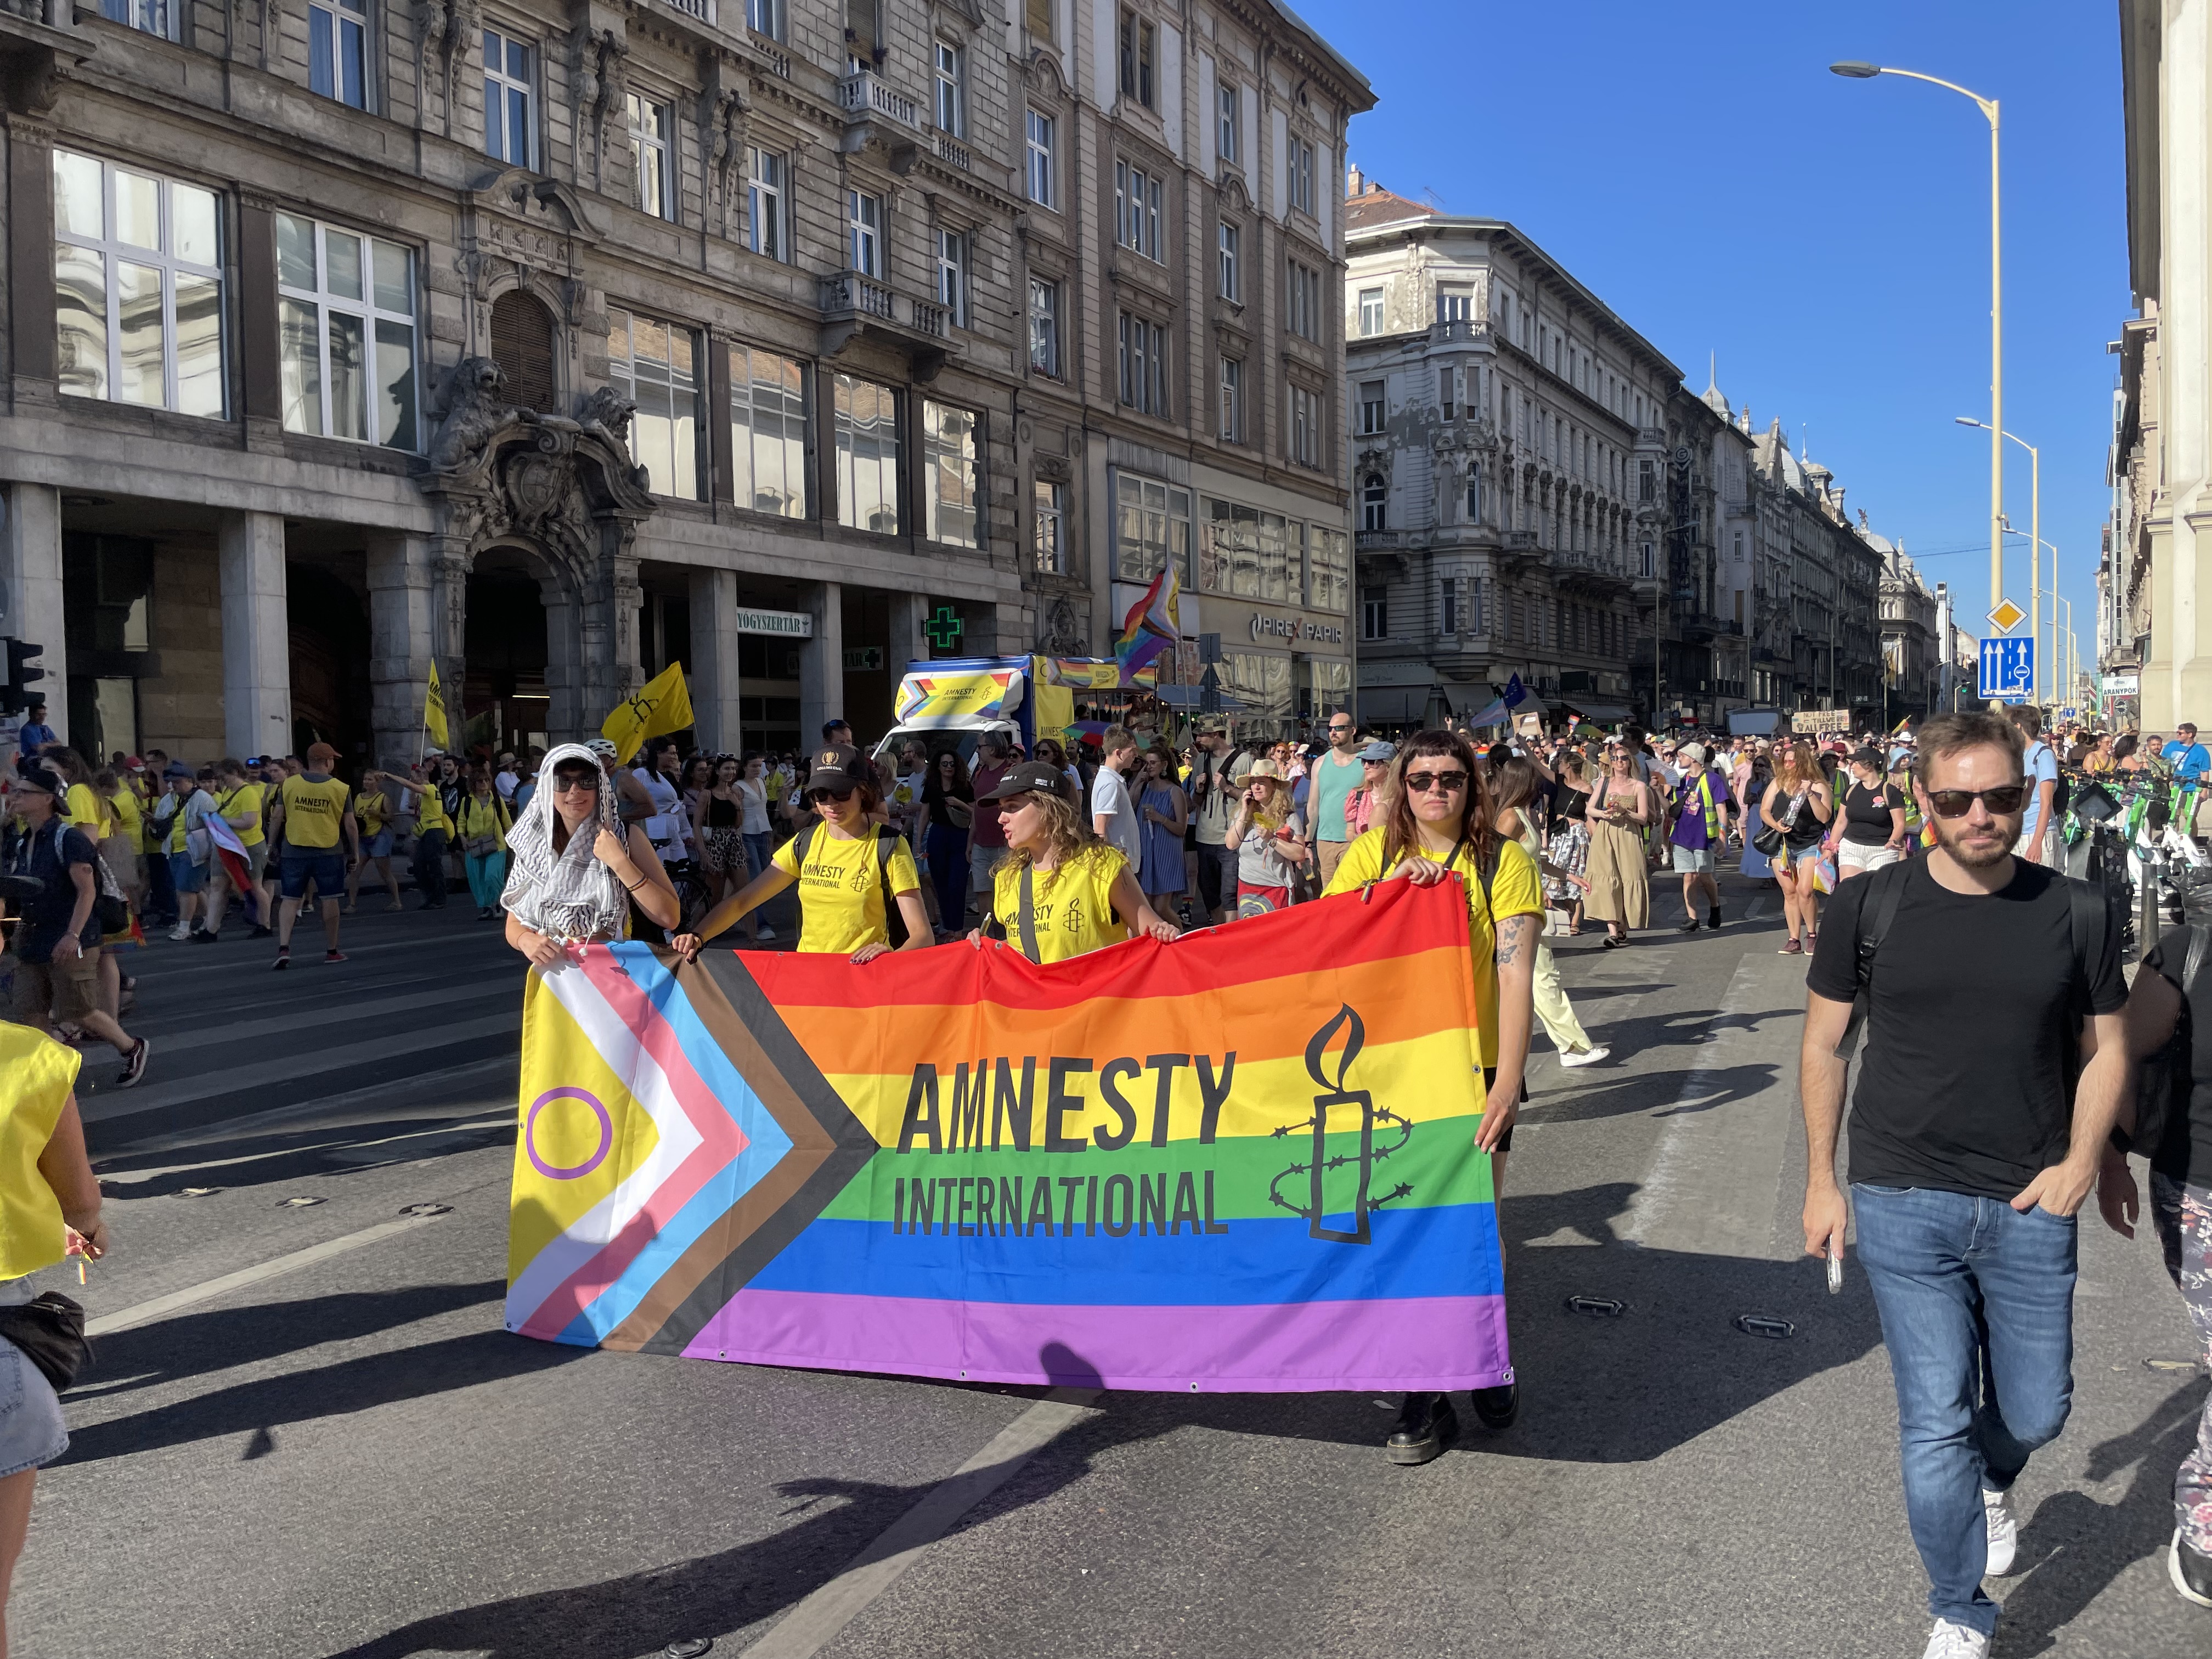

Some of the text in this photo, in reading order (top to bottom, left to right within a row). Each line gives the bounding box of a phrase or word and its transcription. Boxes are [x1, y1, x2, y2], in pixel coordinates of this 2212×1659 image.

[737, 611, 800, 633] YÓGYSZERTÁR
[1262, 617, 1343, 645] PIREX PAPIR
[944, 687, 977, 696] AMNESTY
[2103, 686, 2137, 695] ARANYPÓK
[1819, 723, 1842, 732] FREE
[295, 796, 330, 808] AMNESTY
[803, 864, 846, 879] AMNESTY
[1005, 904, 1054, 925] AMSTY
[896, 1051, 1237, 1154] AMNESTY
[893, 1170, 1228, 1237] INTERNATIONAL
